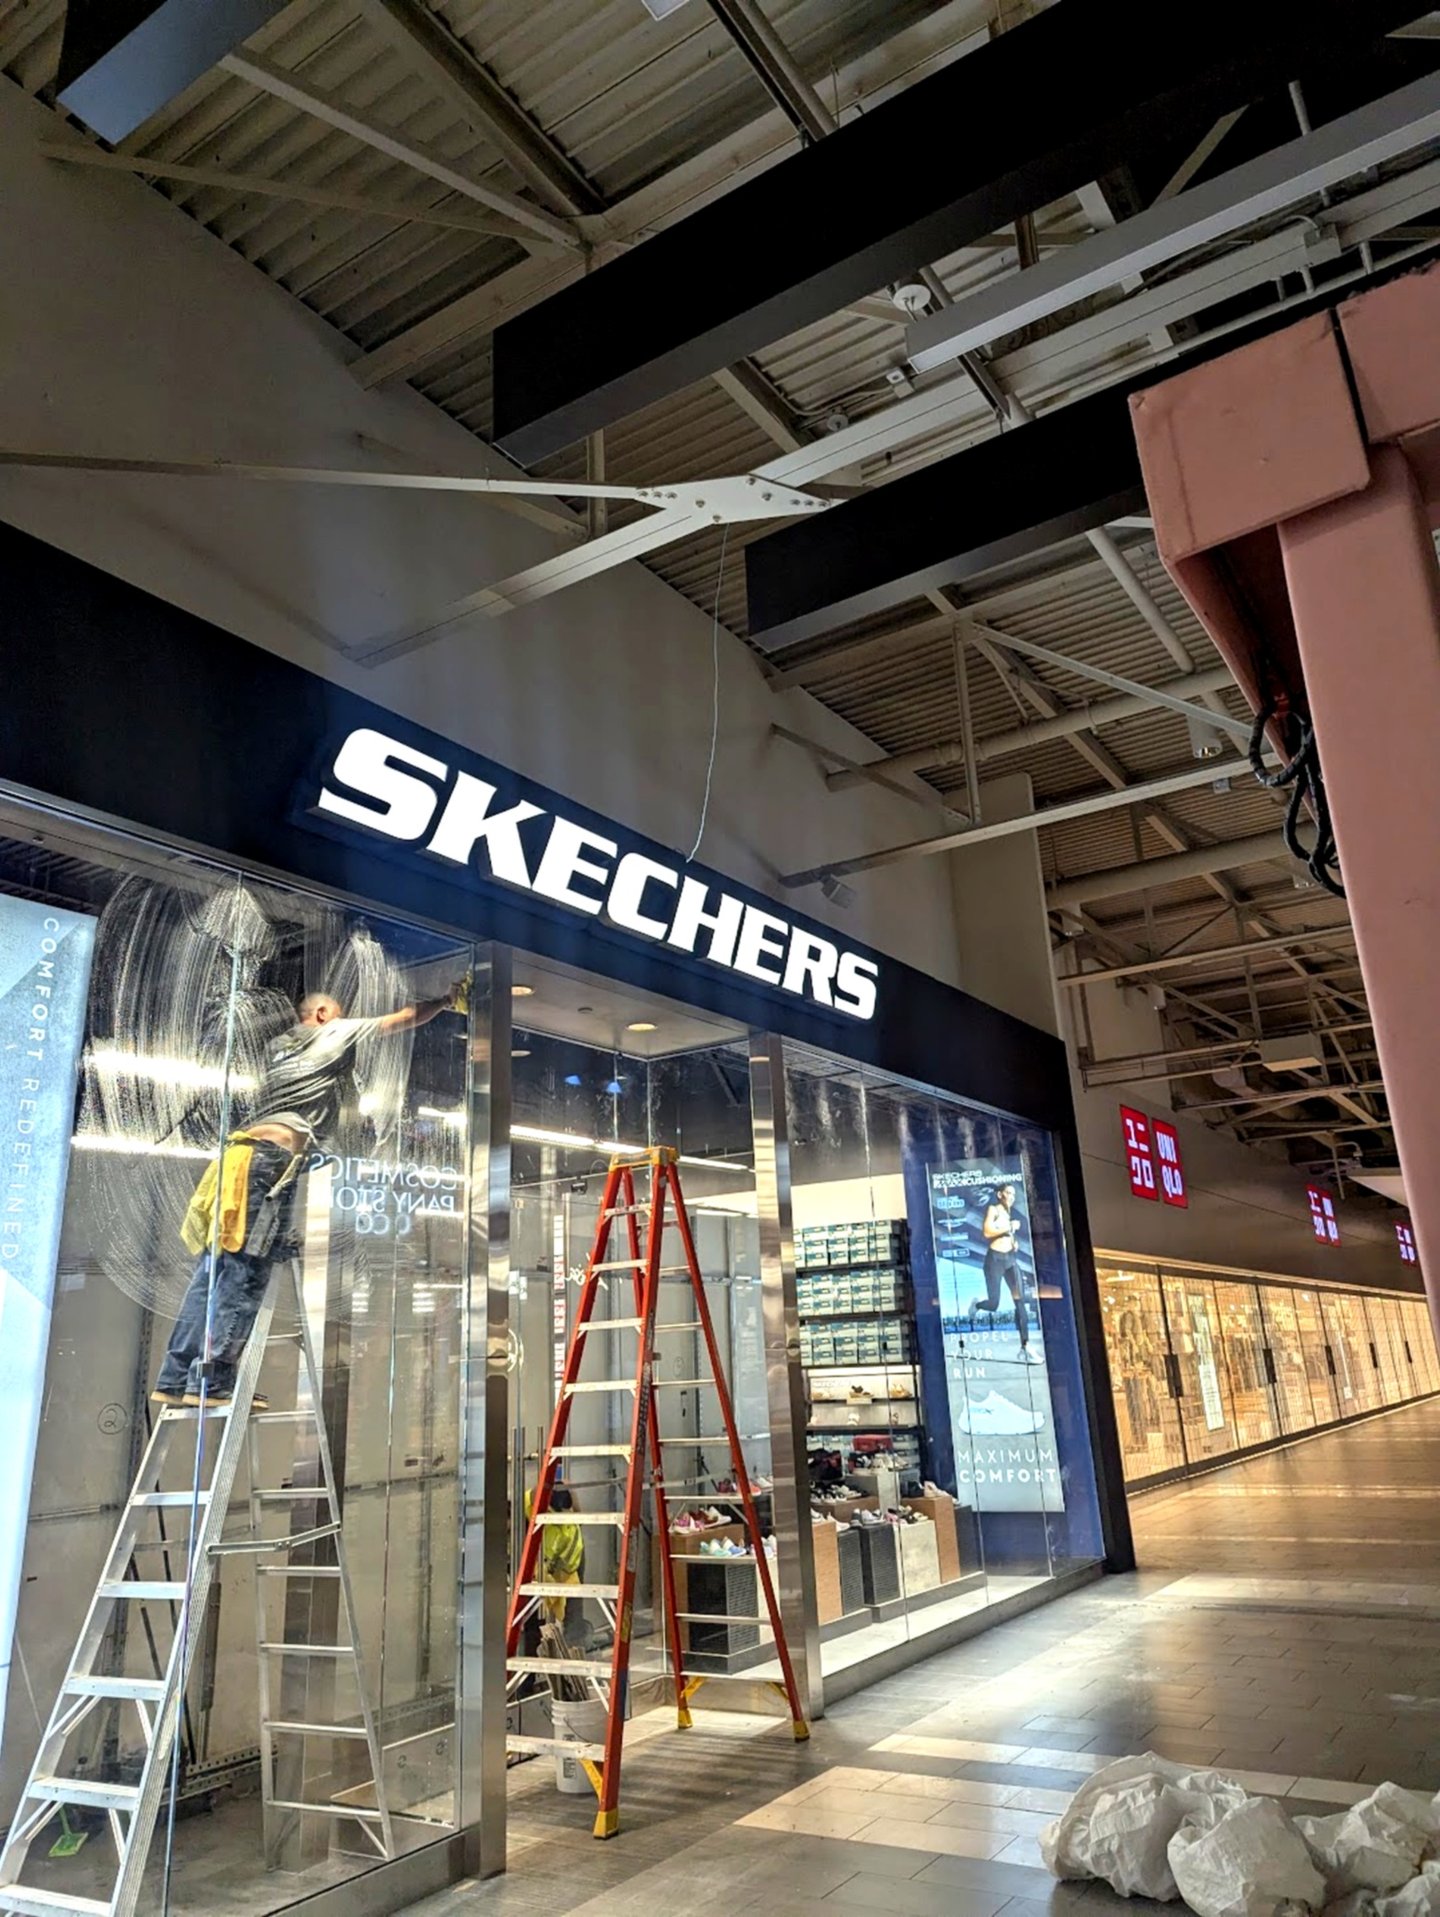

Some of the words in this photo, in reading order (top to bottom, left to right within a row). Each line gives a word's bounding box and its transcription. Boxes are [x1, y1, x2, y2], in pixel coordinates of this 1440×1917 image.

[317, 728, 879, 1021] SKECHERS
[26, 917, 60, 1062] COMFORT
[1, 1078, 41, 1260] REDEFINED
[949, 1330, 1009, 1343] PROPEL
[951, 1349, 993, 1360] YOUR
[953, 1367, 986, 1379] RUN
[957, 1449, 1054, 1463] MAXIMUM
[959, 1469, 1057, 1483] COMFORT
